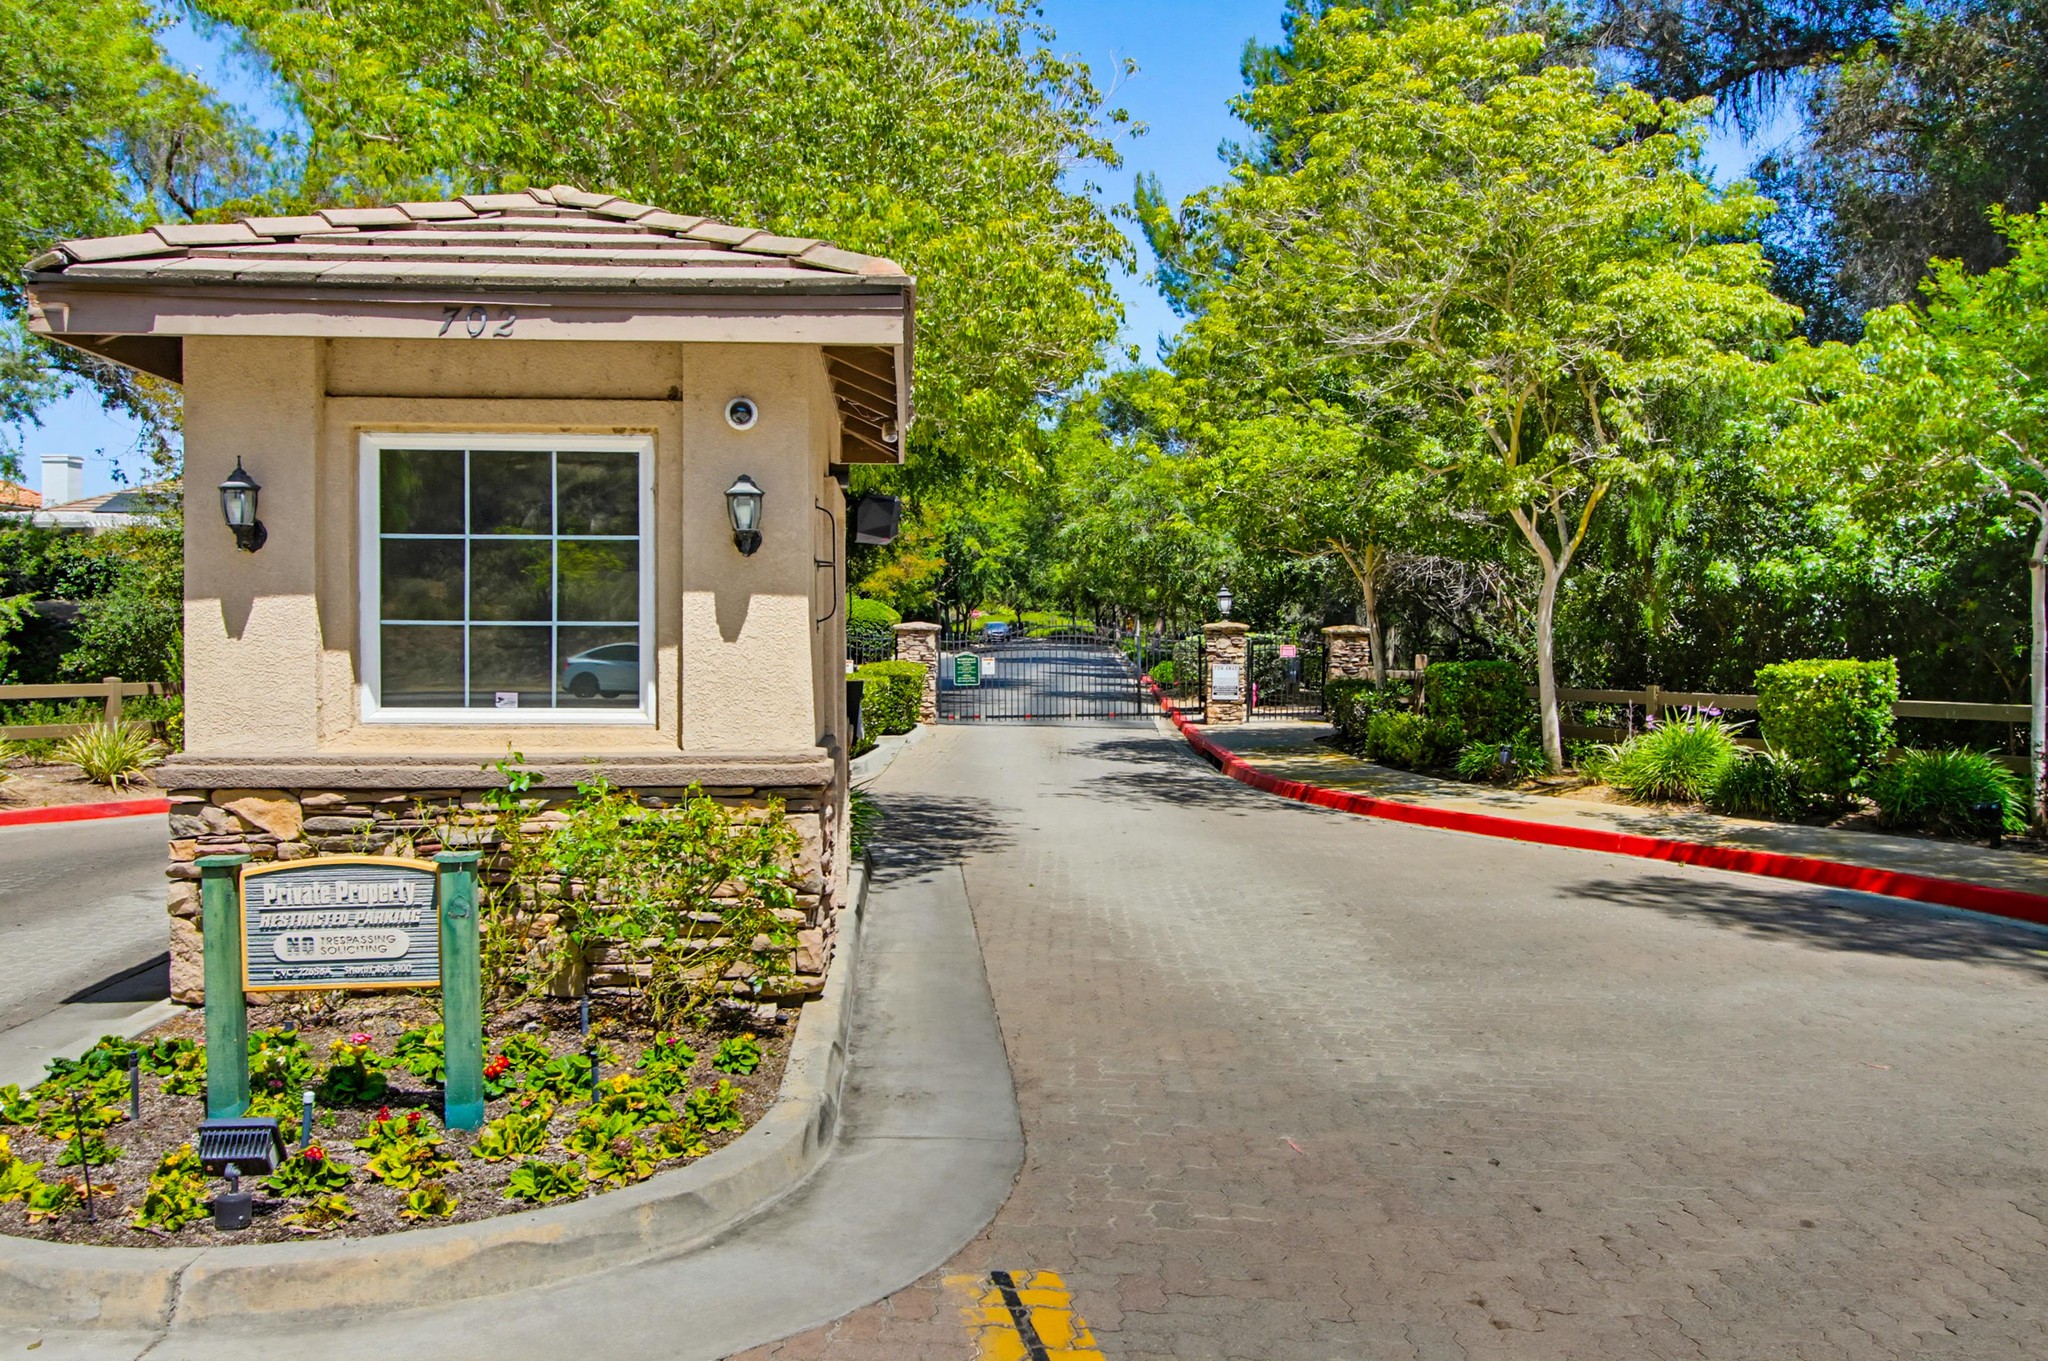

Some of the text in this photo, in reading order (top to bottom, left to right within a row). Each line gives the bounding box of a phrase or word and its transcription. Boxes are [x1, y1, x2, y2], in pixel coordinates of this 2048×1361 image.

[438, 305, 517, 338] 702
[263, 879, 416, 907] Private Property
[259, 909, 422, 928] RESTRICTED PARKING
[286, 934, 397, 956] NO TRESPASSING
[320, 944, 388, 956] SOLICITING
